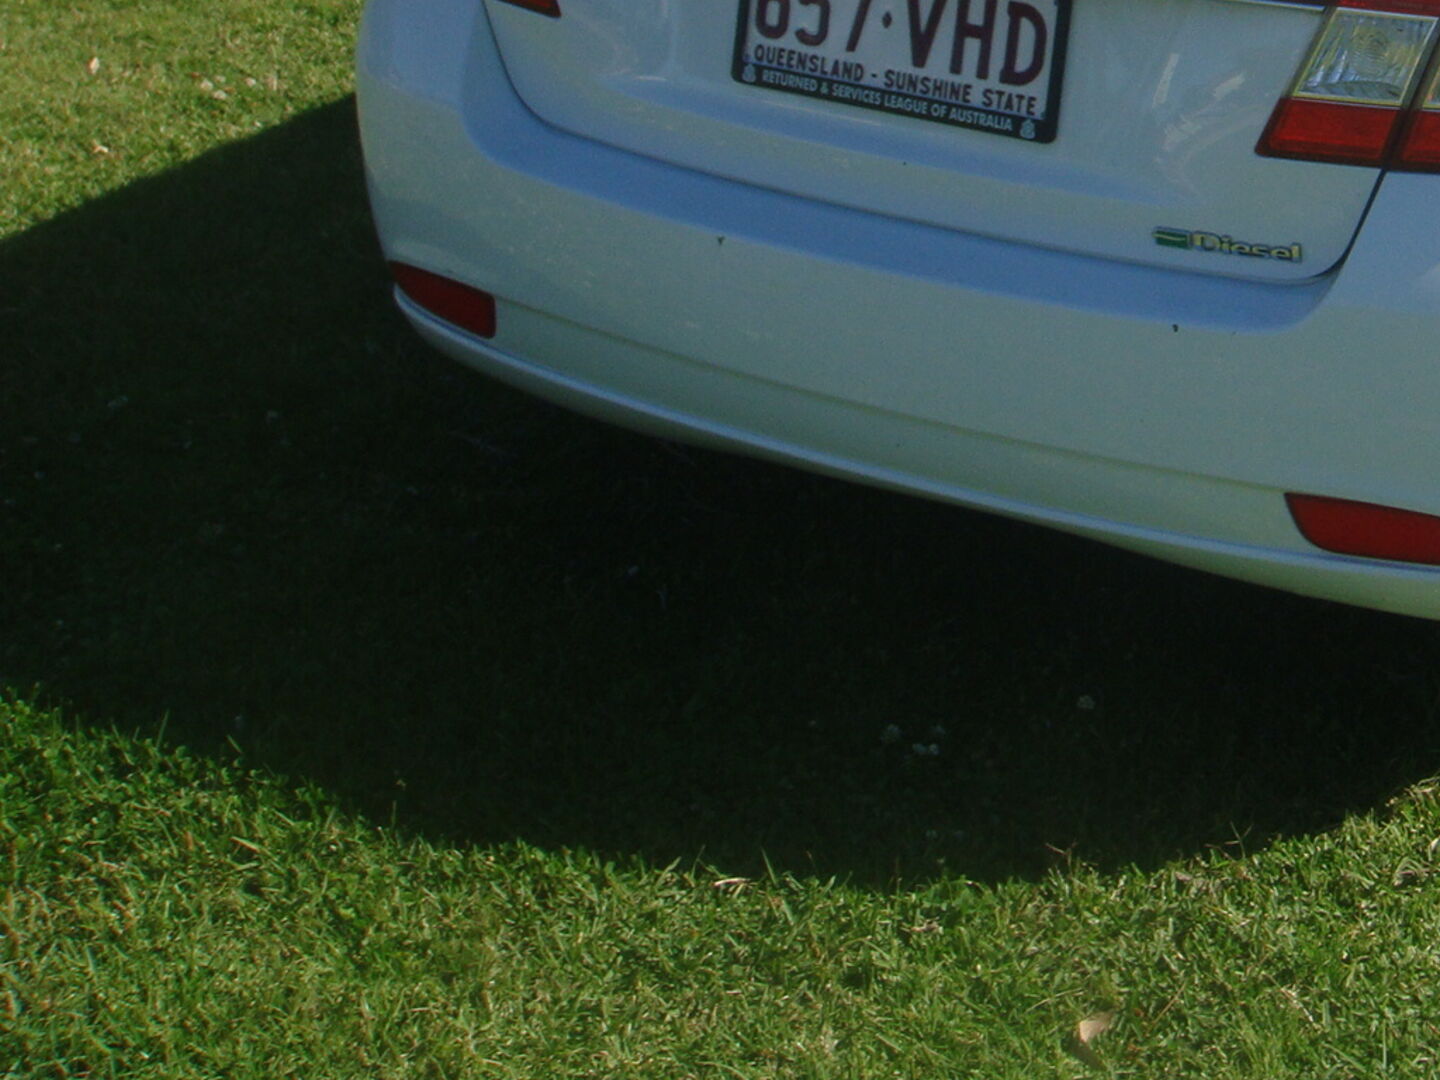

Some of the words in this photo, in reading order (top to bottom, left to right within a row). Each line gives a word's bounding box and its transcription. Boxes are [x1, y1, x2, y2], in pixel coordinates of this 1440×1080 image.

[754, 44, 865, 82] QUEENSLAND
[884, 69, 973, 103] SUNSHINE
[982, 88, 1037, 116] STATE
[762, 70, 819, 93] RETURNED
[820, 81, 829, 94] &
[832, 84, 882, 105] SERVICES
[884, 95, 928, 114] LEAGUE
[930, 103, 948, 117] OF
[949, 108, 1013, 131] AUSTRALIA
[1192, 230, 1303, 263] Diesel
